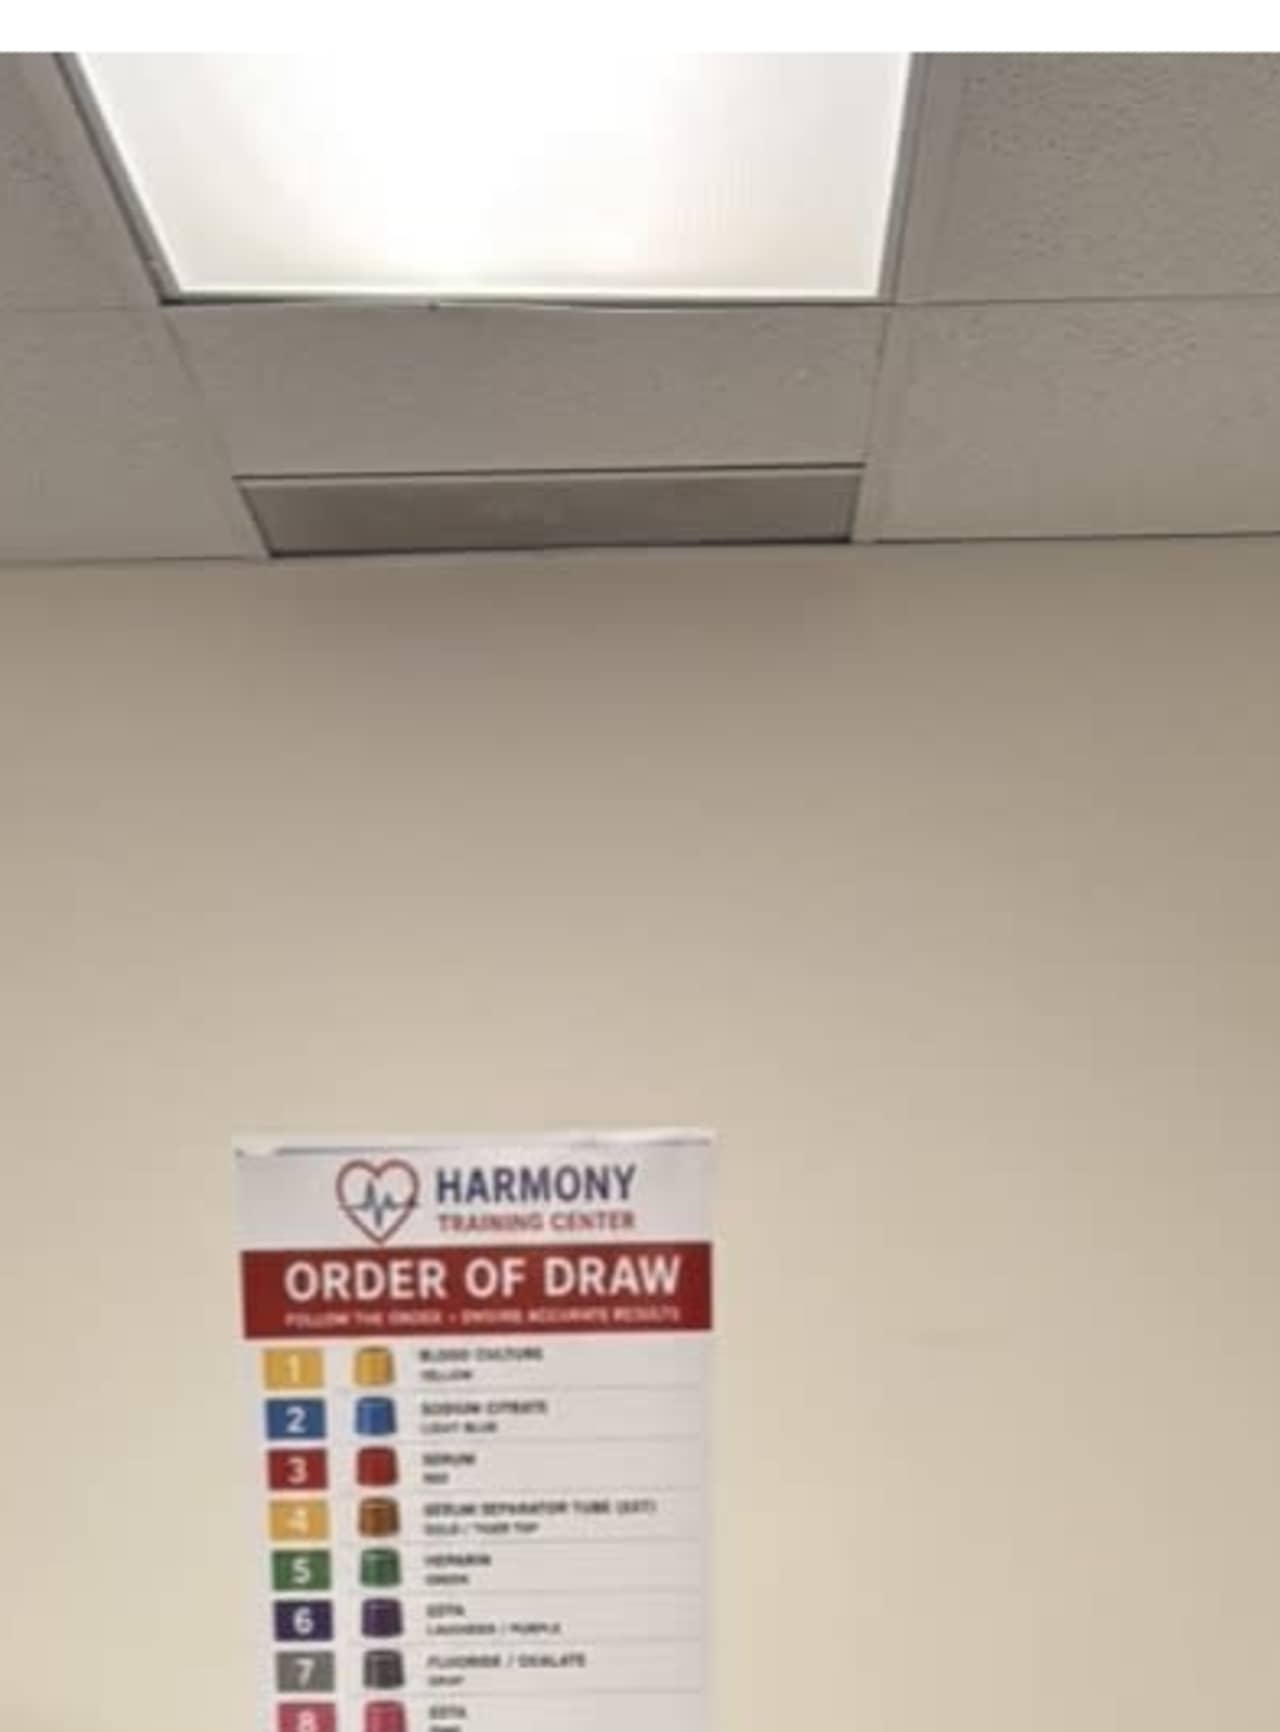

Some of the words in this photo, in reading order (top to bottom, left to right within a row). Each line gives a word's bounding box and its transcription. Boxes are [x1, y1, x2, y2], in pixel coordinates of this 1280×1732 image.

[436, 1164, 636, 1204] HARMONY
[438, 1213, 543, 1233] TRAINING
[550, 1211, 635, 1231] CENTER
[284, 1260, 447, 1301] ORDER
[464, 1257, 526, 1299] OF
[544, 1254, 682, 1296] DRAW
[284, 1353, 300, 1383] 1
[285, 1405, 307, 1435] 2
[285, 1456, 309, 1485] 3
[286, 1506, 310, 1535] 4
[291, 1557, 312, 1585] 5
[293, 1606, 315, 1636] 6
[295, 1657, 315, 1687] 7
